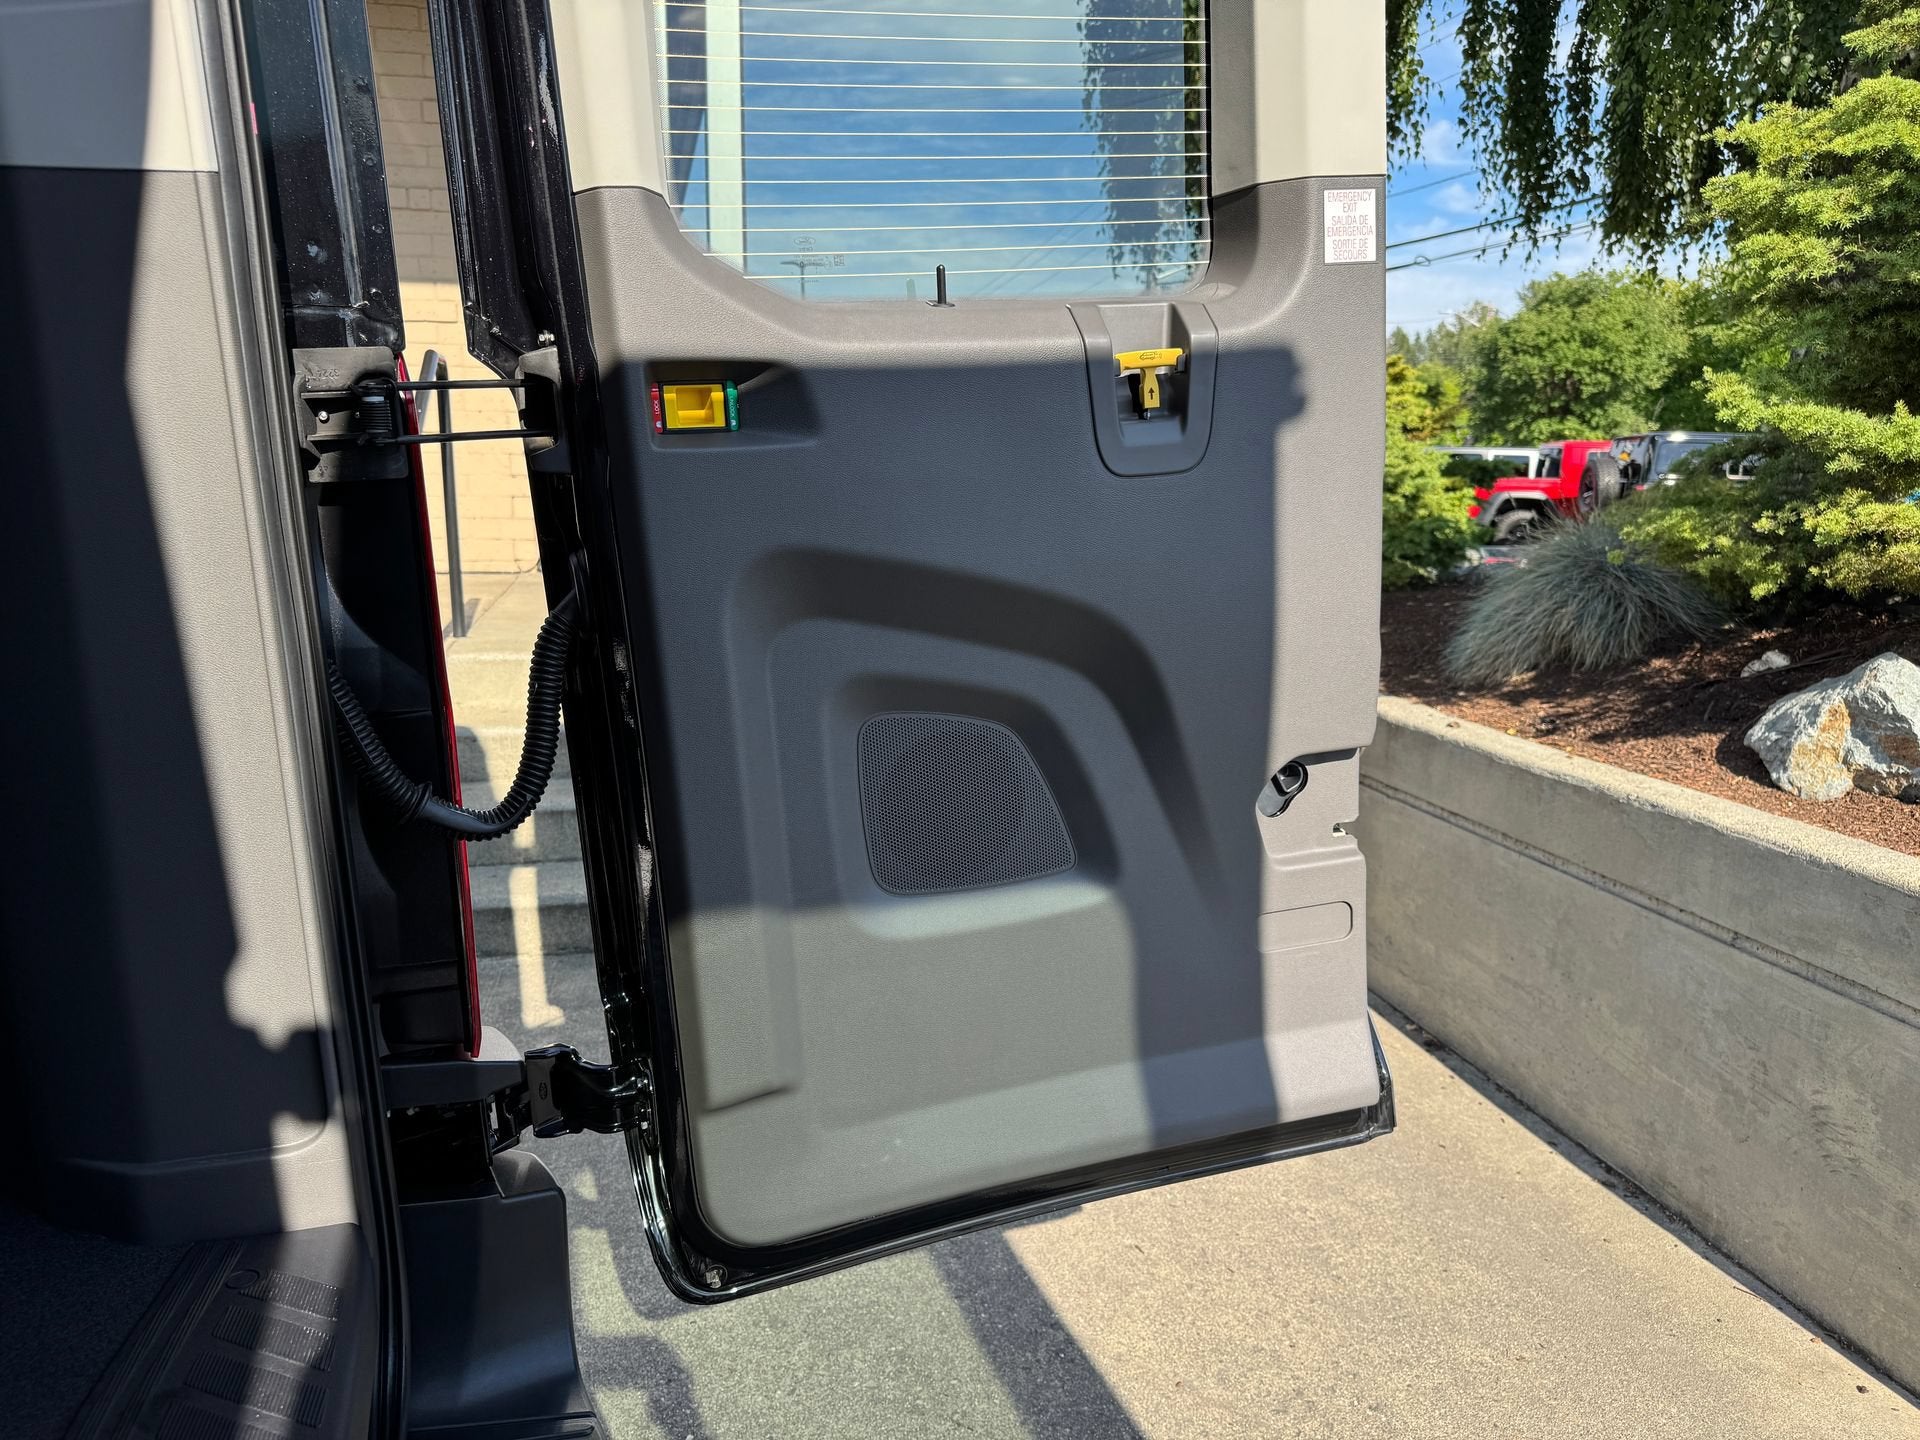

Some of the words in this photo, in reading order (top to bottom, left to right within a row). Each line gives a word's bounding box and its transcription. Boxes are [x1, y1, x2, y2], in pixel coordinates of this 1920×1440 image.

[1328, 191, 1372, 202] EMERGENCY
[1343, 202, 1357, 213] EXIT
[1332, 215, 1357, 226] SALIDA
[1359, 214, 1368, 225] DE
[1327, 225, 1373, 237] EMERGENCIA
[1332, 239, 1357, 250] SORTIE
[1359, 238, 1368, 249] DE
[1333, 249, 1368, 260] SECOURS
